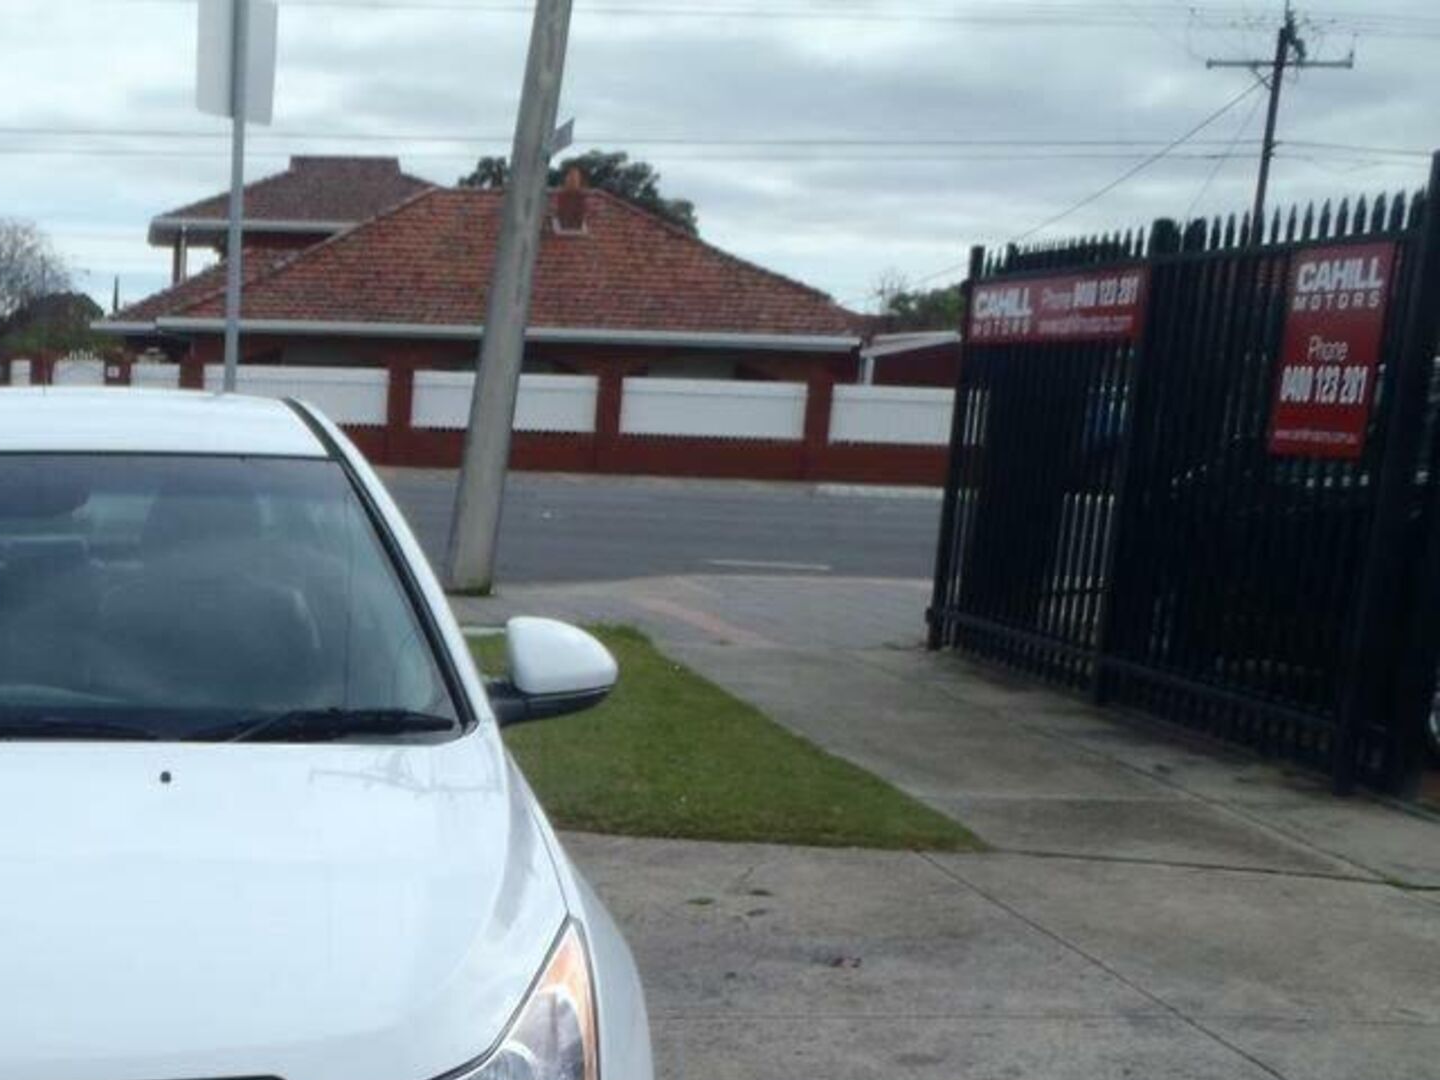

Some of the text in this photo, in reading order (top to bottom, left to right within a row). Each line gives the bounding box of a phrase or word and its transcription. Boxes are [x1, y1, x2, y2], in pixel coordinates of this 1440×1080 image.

[1297, 257, 1383, 292] CAHILL
[973, 287, 1033, 319] CAHILL
[1293, 290, 1381, 311] MOTORS
[1307, 334, 1349, 362] Phone
